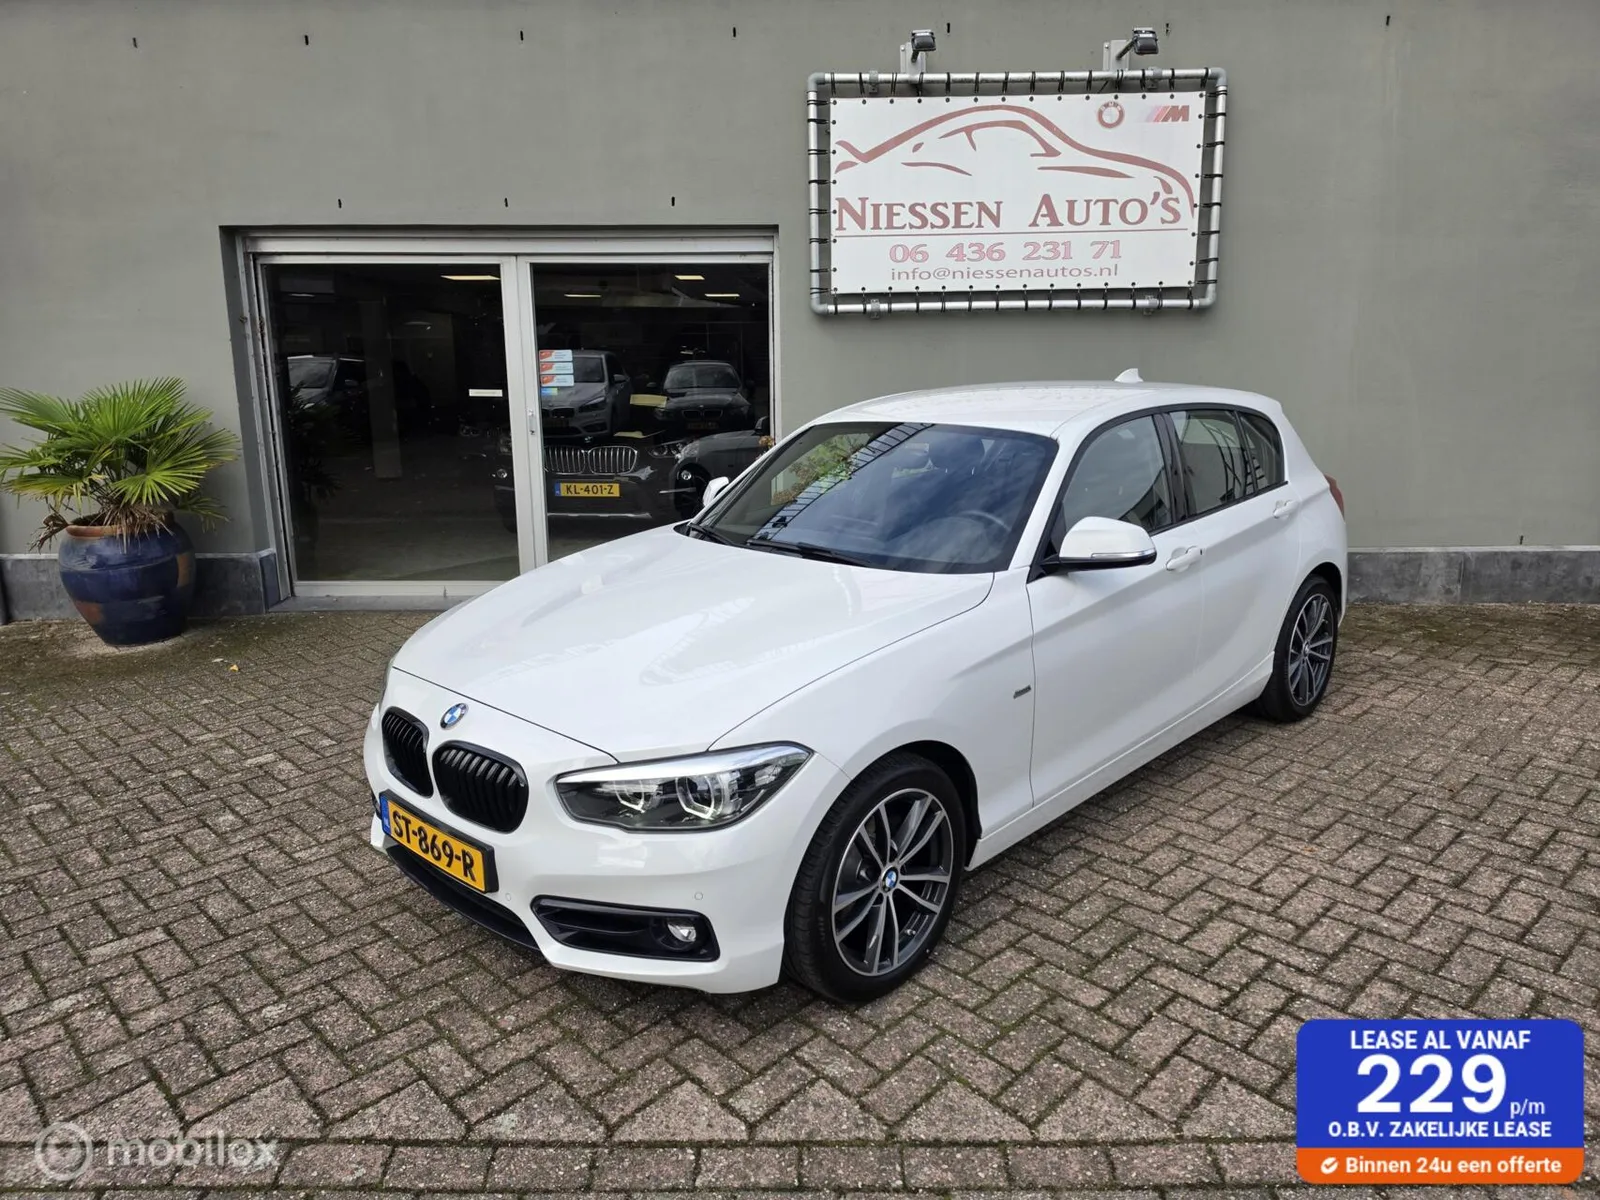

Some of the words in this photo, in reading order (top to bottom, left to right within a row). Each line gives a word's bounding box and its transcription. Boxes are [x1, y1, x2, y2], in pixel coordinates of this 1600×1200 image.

[835, 196, 1003, 231] NIESSEN
[1028, 191, 1182, 228] AUTO'S
[889, 243, 930, 263] 06
[945, 242, 1006, 262] 436
[1022, 240, 1073, 261] 231
[1090, 239, 1122, 260] 71
[891, 263, 1118, 281] info@niessenautos.nl
[565, 484, 615, 495] KL-401-Z
[392, 810, 477, 882] ST-869-R
